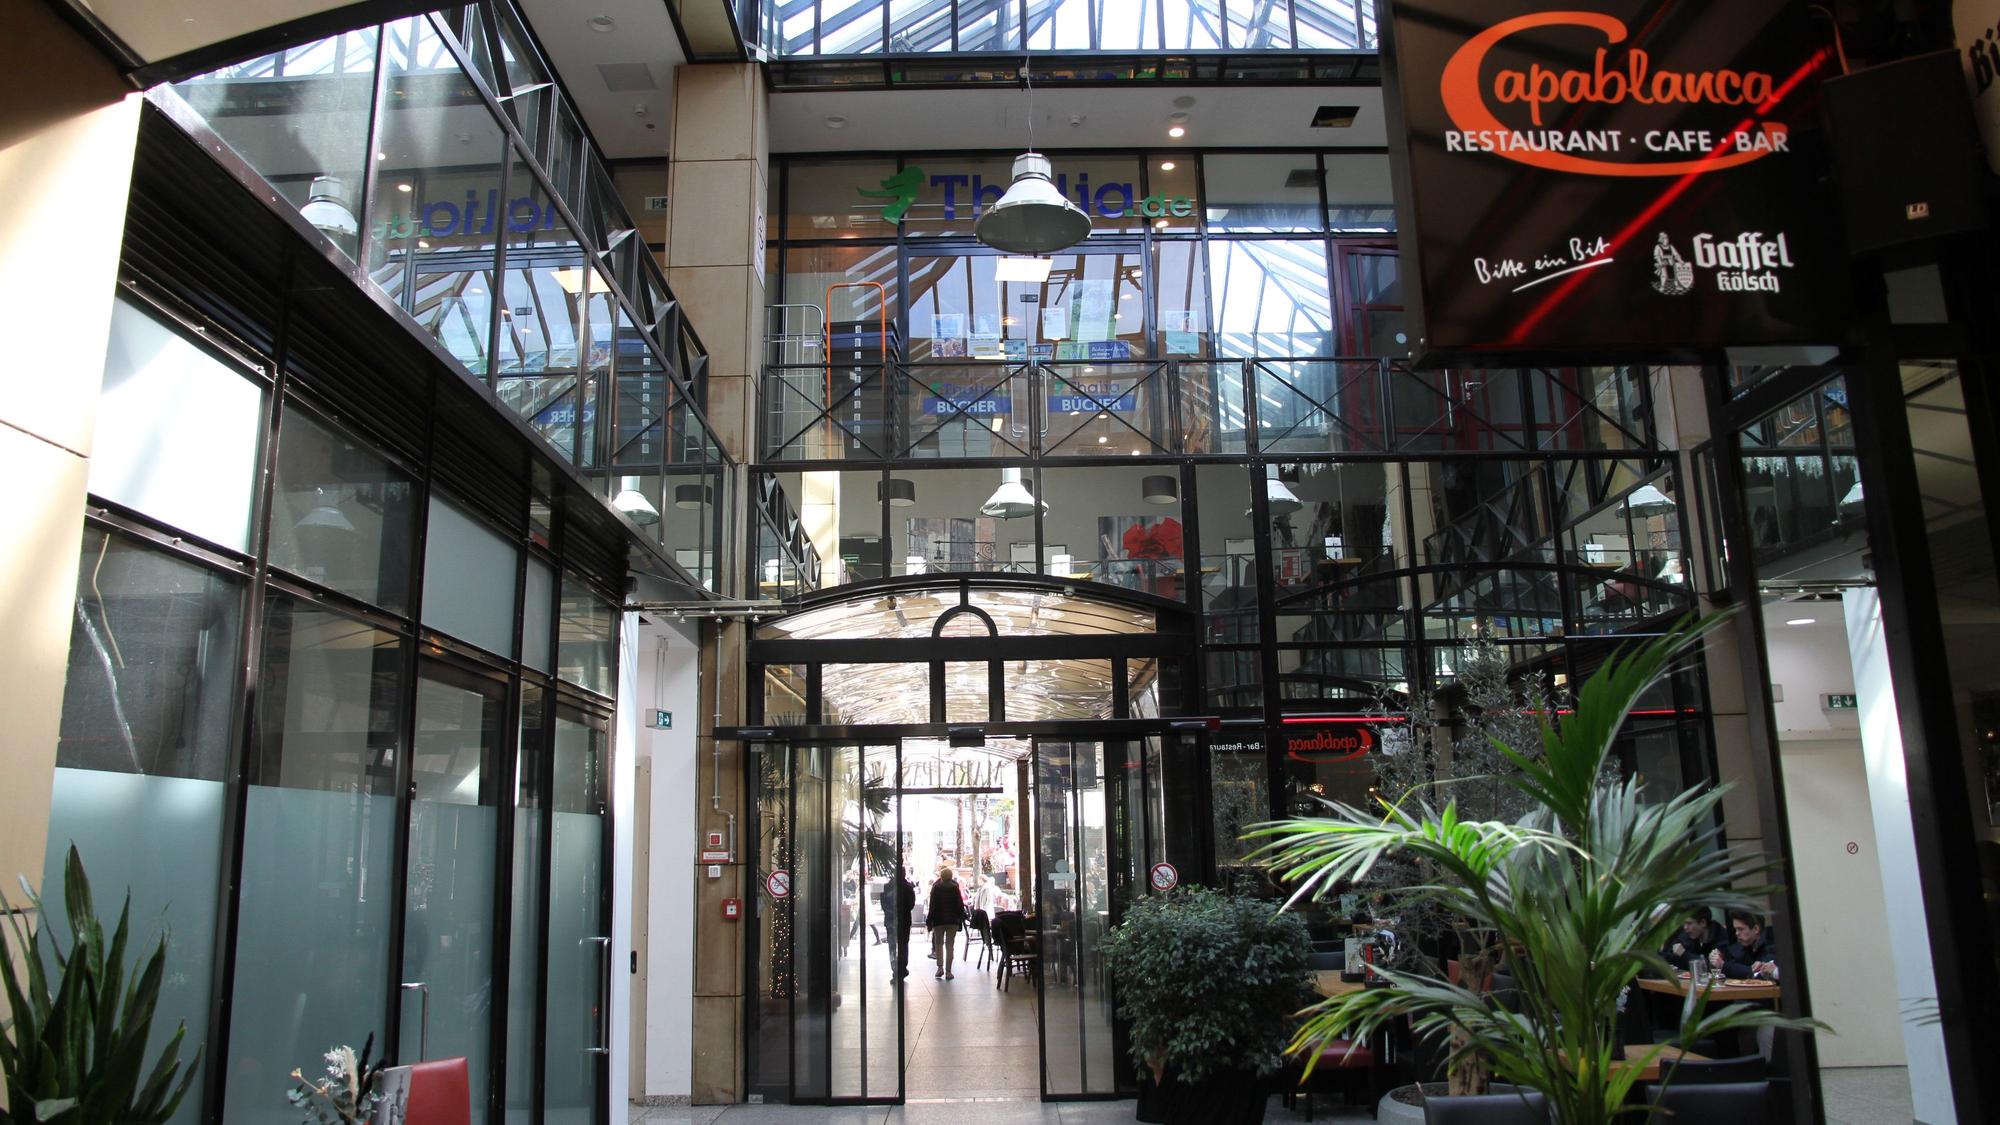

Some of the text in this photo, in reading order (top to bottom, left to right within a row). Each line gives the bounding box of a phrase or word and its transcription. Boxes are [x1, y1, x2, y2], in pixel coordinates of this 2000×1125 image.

[1441, 11, 1788, 176] Capablanca
[1445, 130, 1791, 153] RESTAURANT CAFE BAR
[930, 173, 1193, 221] Thlia.de
[1474, 236, 1611, 284] Bitte ein Bit
[1694, 231, 1795, 270] Gaffel
[936, 397, 997, 413] BÜCHER
[1061, 396, 1122, 411] BÜCHER
